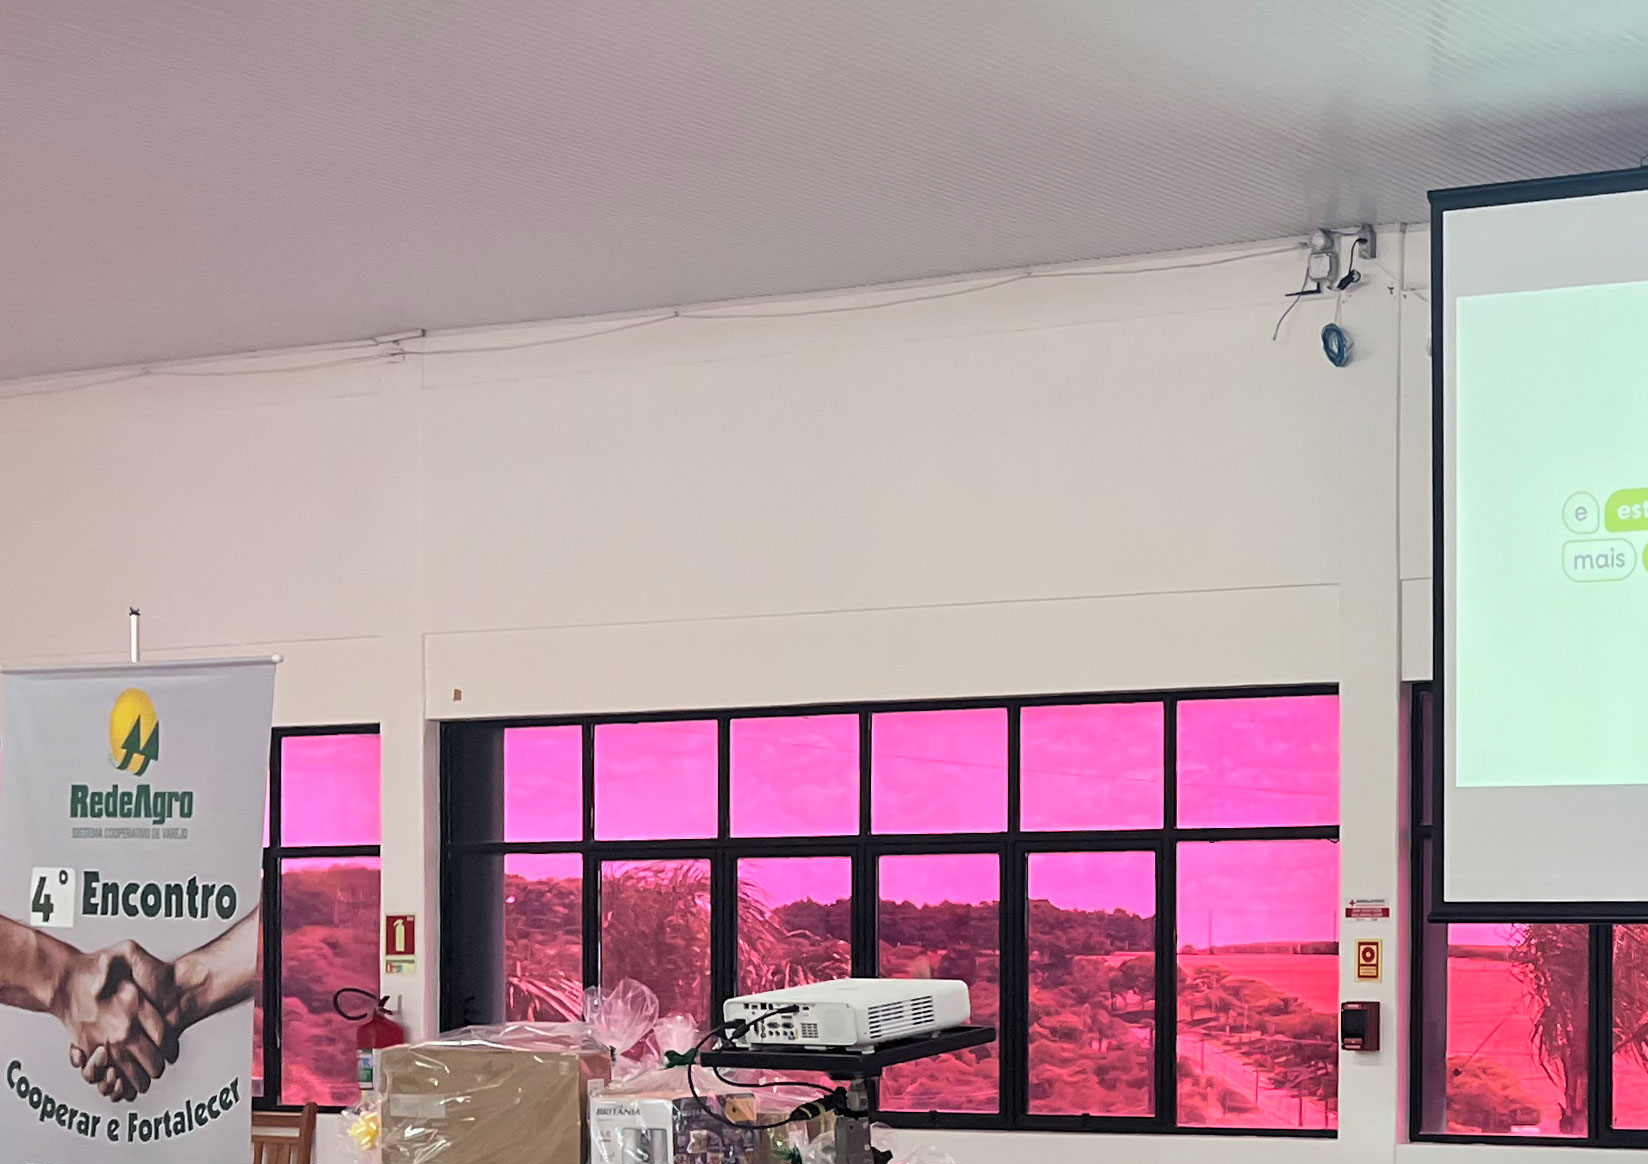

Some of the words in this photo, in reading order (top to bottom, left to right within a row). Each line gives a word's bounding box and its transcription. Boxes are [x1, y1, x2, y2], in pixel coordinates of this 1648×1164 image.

[1574, 506, 1588, 521] e
[1574, 547, 1626, 570] mais
[69, 784, 194, 825] RedeAgro
[72, 827, 103, 839] SISTEMA
[104, 827, 150, 839] COOPERATIVO
[152, 828, 161, 839] DE
[162, 828, 188, 840] VAREJO
[82, 870, 237, 920] Encontro
[6, 1060, 102, 1138] Cooperar
[107, 1119, 120, 1142] e
[127, 1077, 241, 1143] Fortalecer
